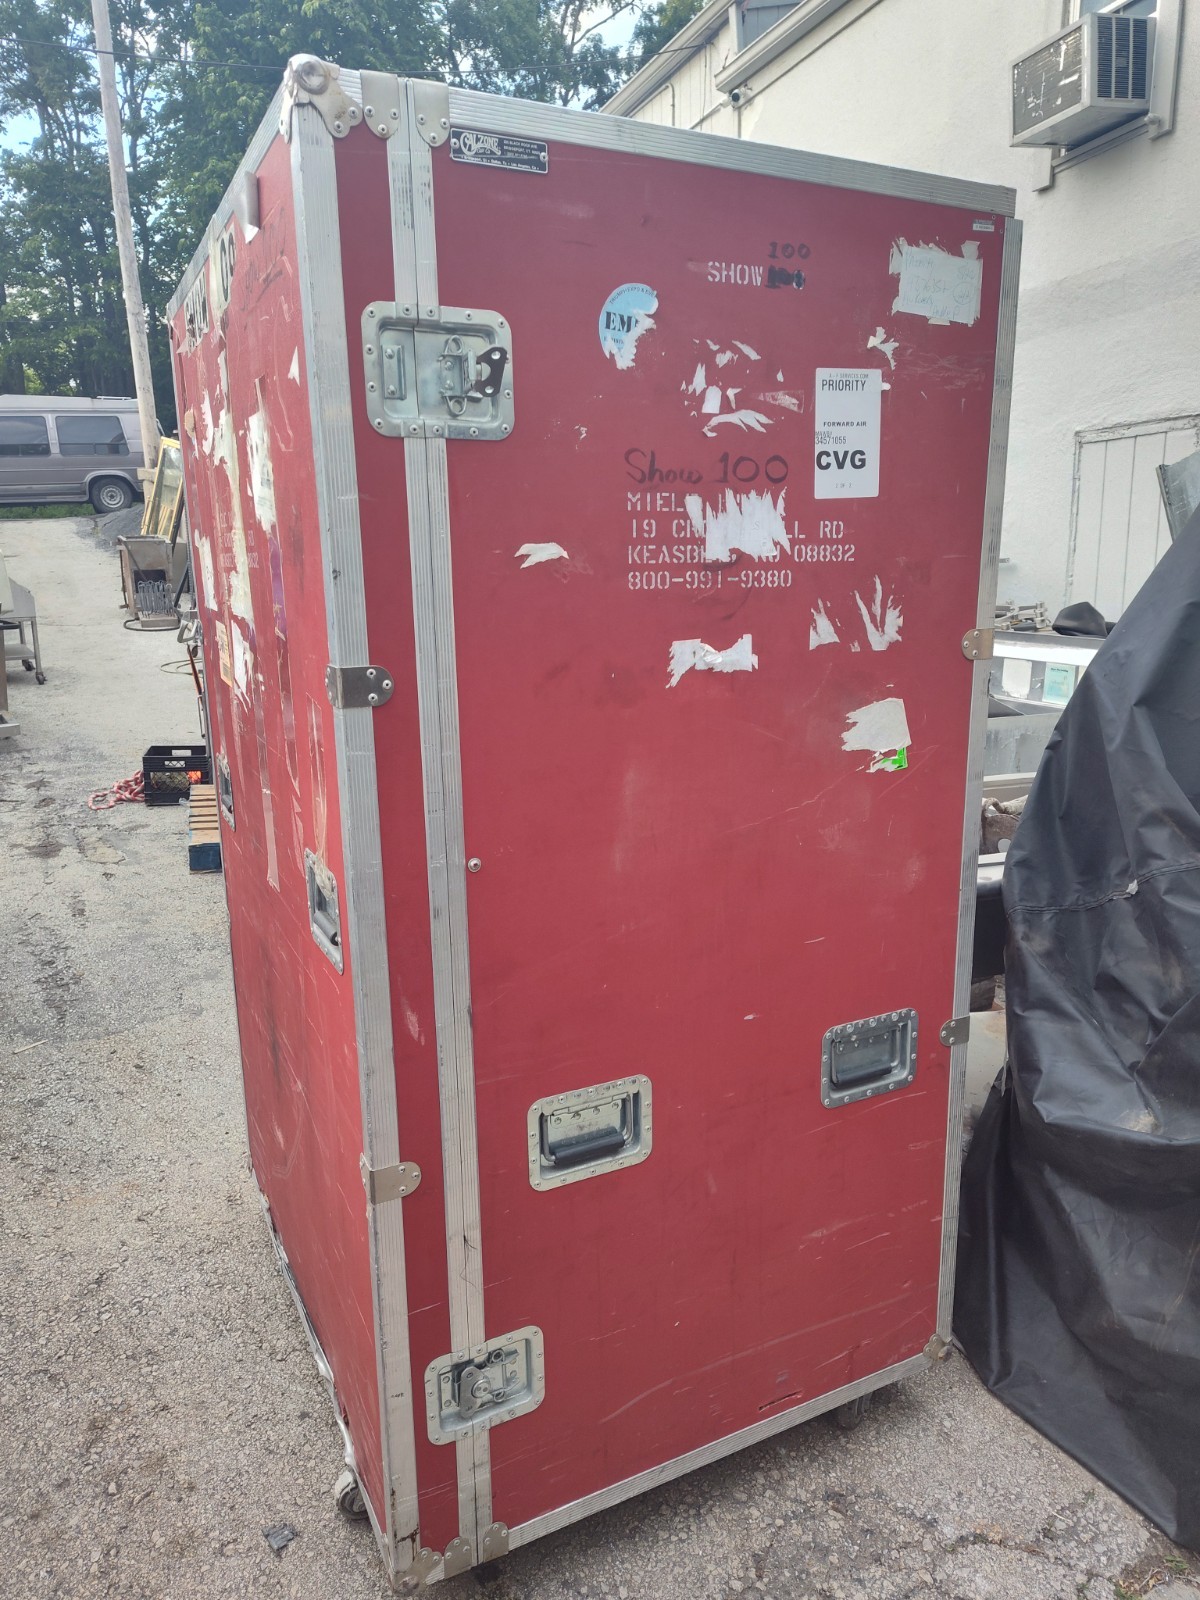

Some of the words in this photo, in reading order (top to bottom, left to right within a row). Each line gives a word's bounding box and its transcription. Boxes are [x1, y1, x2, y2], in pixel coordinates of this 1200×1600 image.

[460, 132, 501, 156] CALZONE
[768, 241, 811, 259] 100
[707, 261, 763, 286] SHOW
[821, 379, 867, 392] PRIORITY
[815, 436, 847, 445] 34571055
[624, 447, 704, 484] Show
[712, 451, 790, 484] 100
[815, 449, 867, 471] CVG
[632, 519, 657, 538] 19
[819, 520, 844, 539] RD
[793, 544, 856, 562] 08832
[627, 569, 793, 590] 800-991-9380
